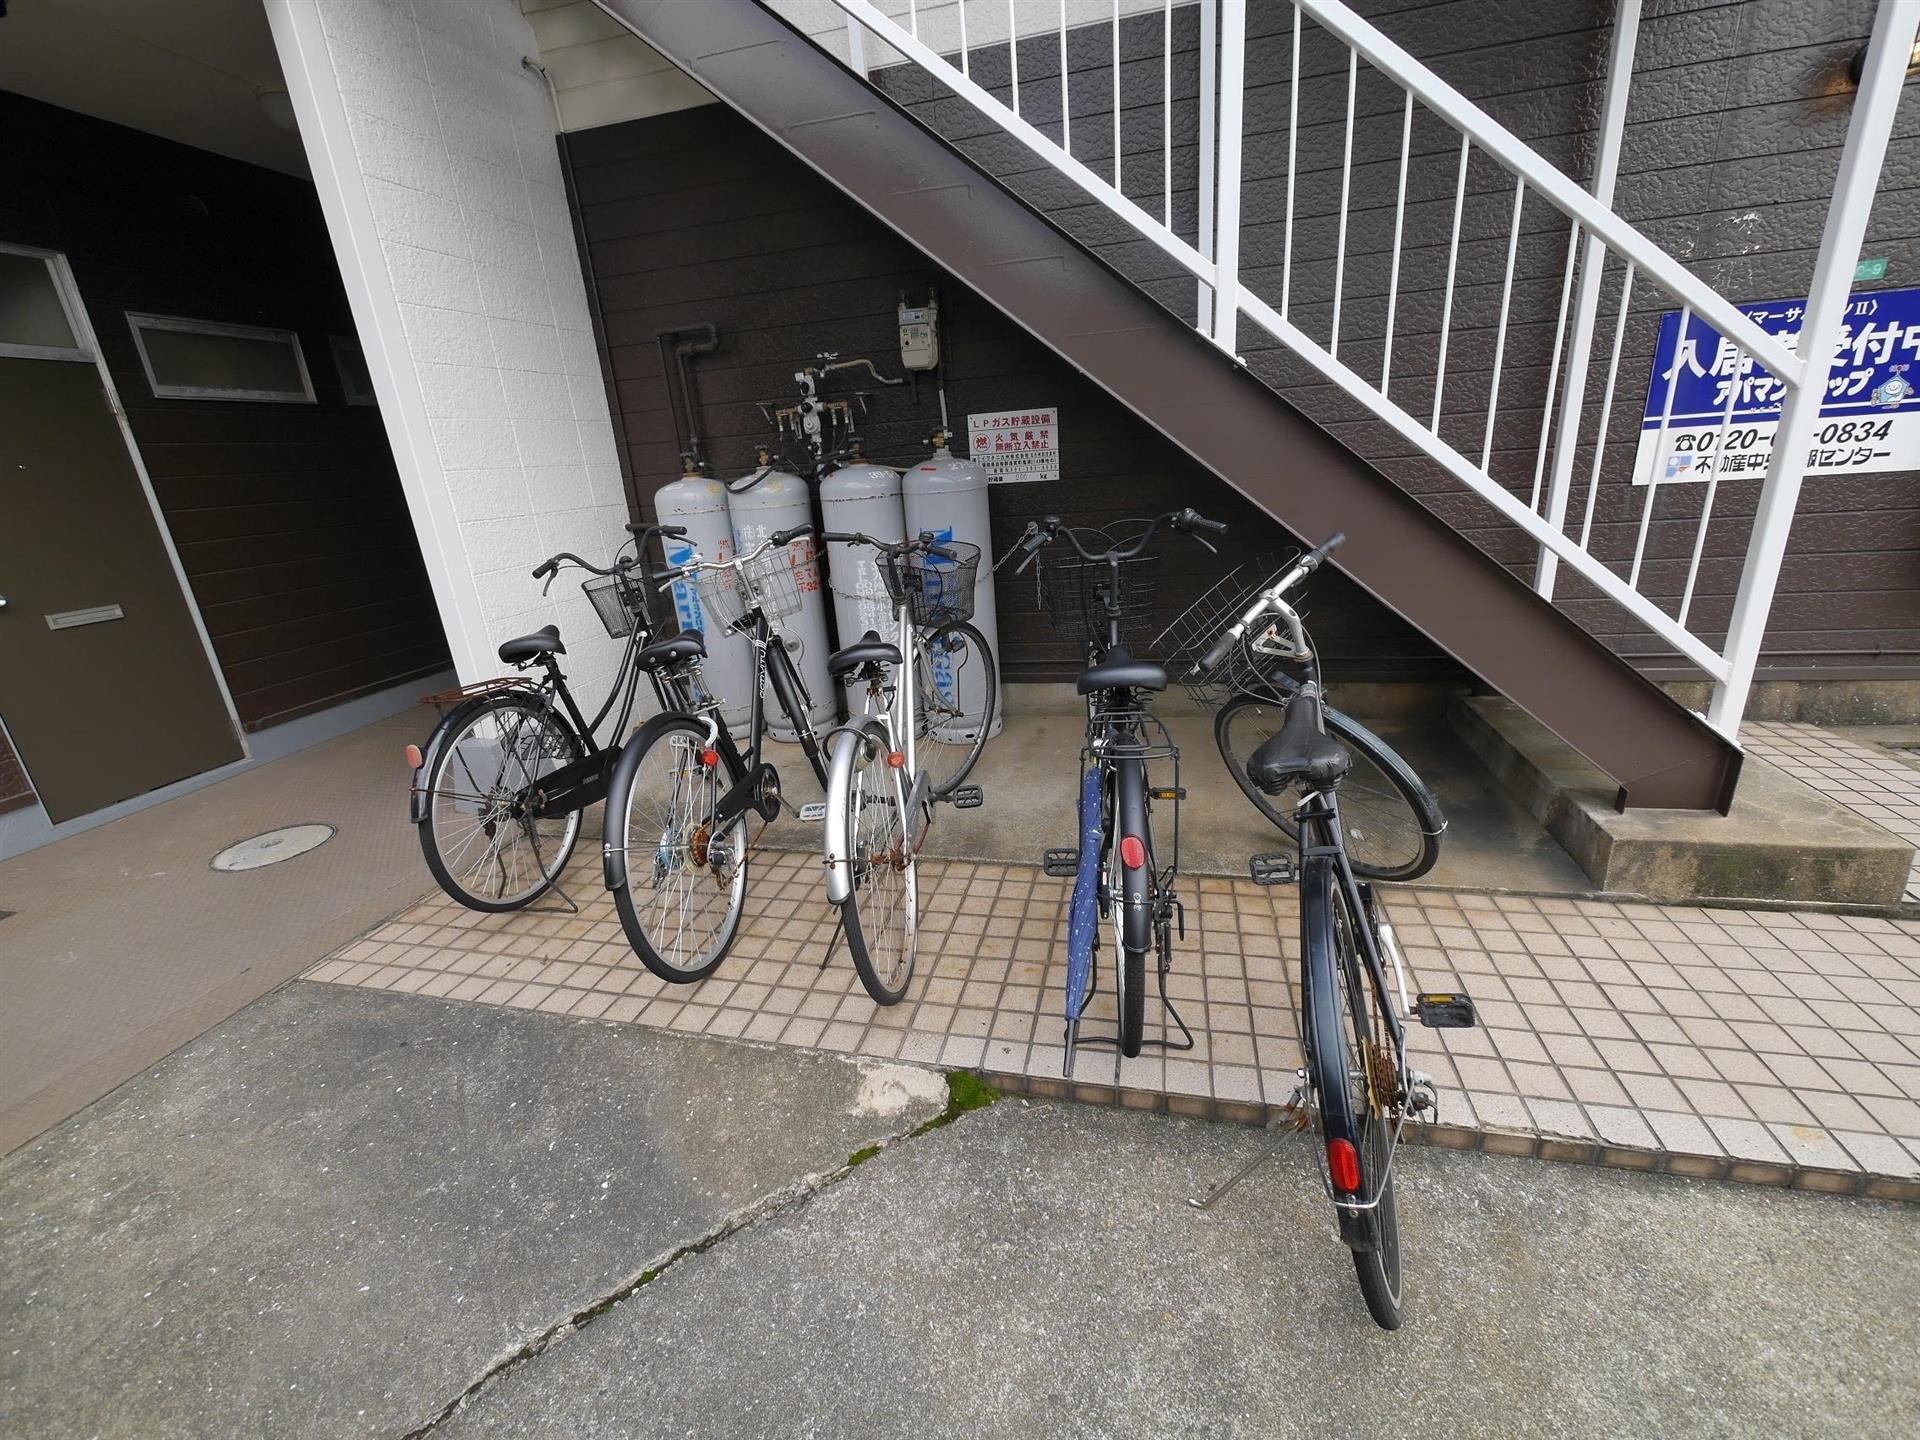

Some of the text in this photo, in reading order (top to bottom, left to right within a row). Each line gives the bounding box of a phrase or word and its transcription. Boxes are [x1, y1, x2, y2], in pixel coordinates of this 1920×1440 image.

[1713, 368, 1874, 406] アパマンップ
[995, 440, 1049, 451] 無断立入禁止
[1697, 420, 1893, 451] 020--0834
